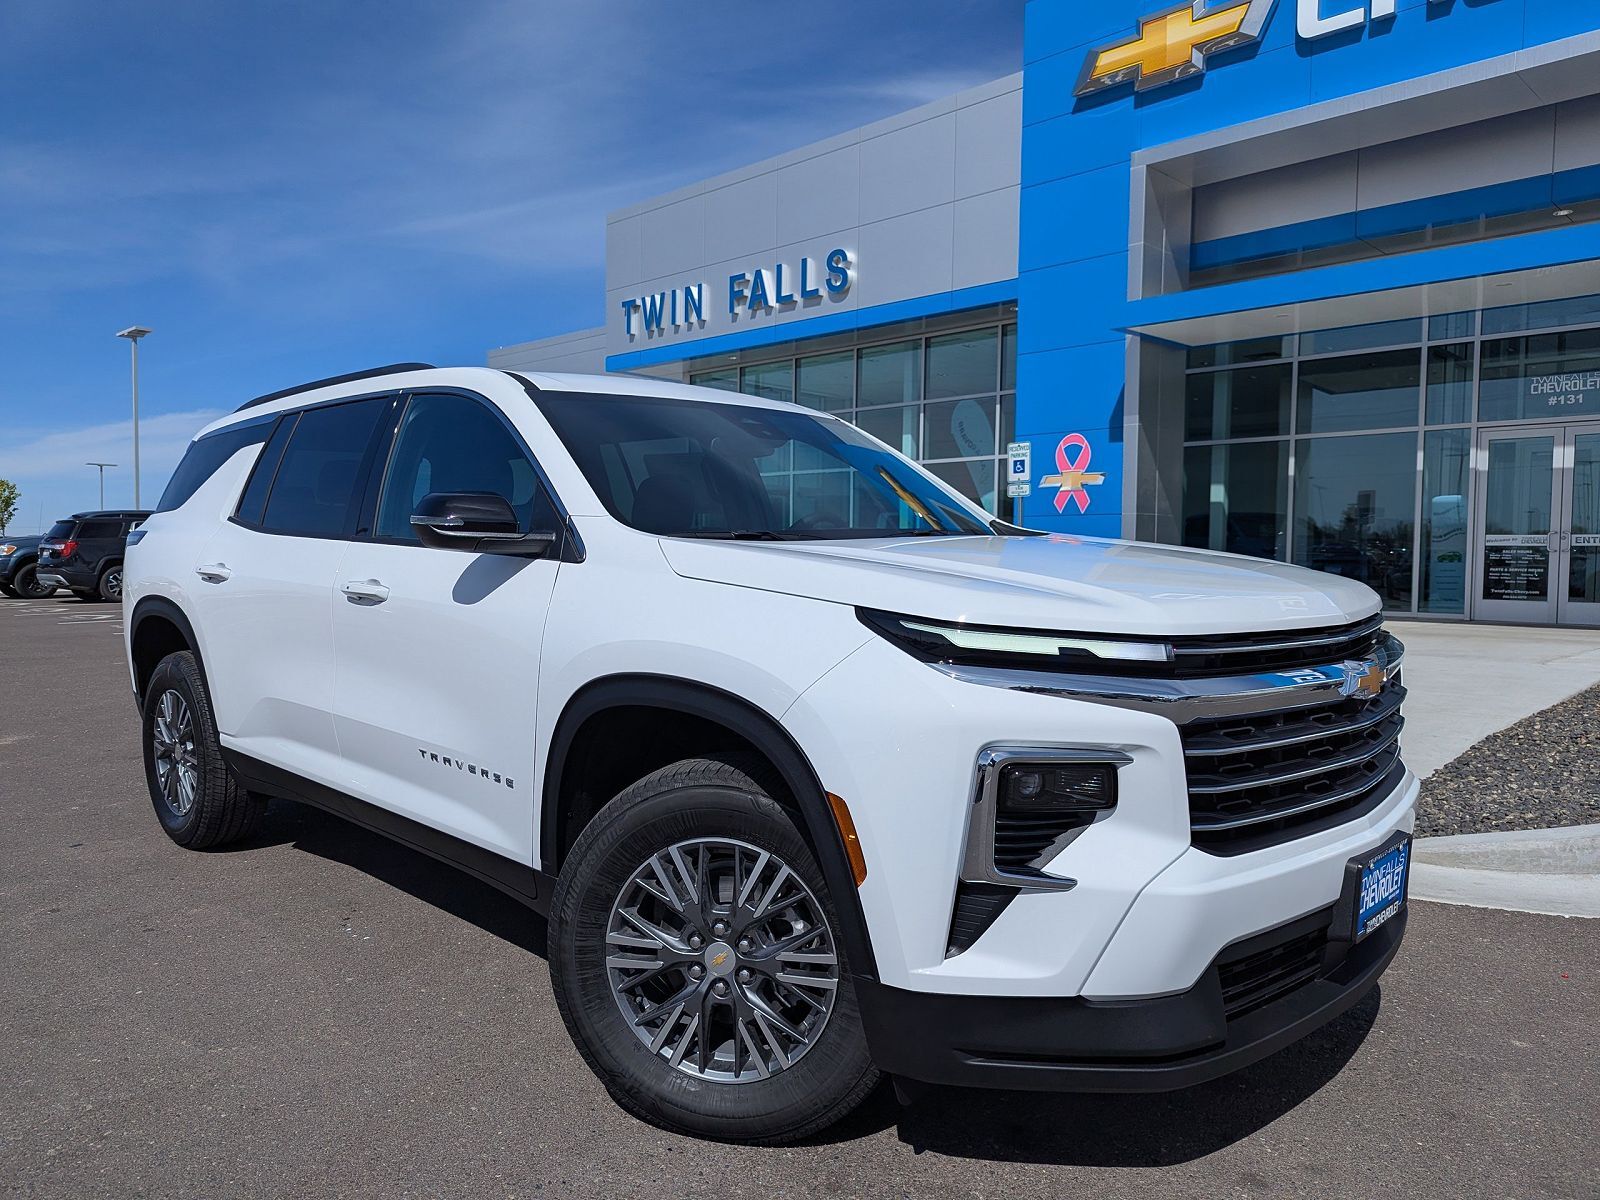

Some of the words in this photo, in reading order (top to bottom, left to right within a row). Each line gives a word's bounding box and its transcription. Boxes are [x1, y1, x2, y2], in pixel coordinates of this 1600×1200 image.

[622, 283, 706, 336] TWIN
[729, 248, 851, 314] FALLS
[1531, 379, 1600, 395] CHEVROLET
[1548, 394, 1583, 406] #131
[1575, 536, 1600, 544] ENT
[419, 748, 514, 789] TRAVERSE
